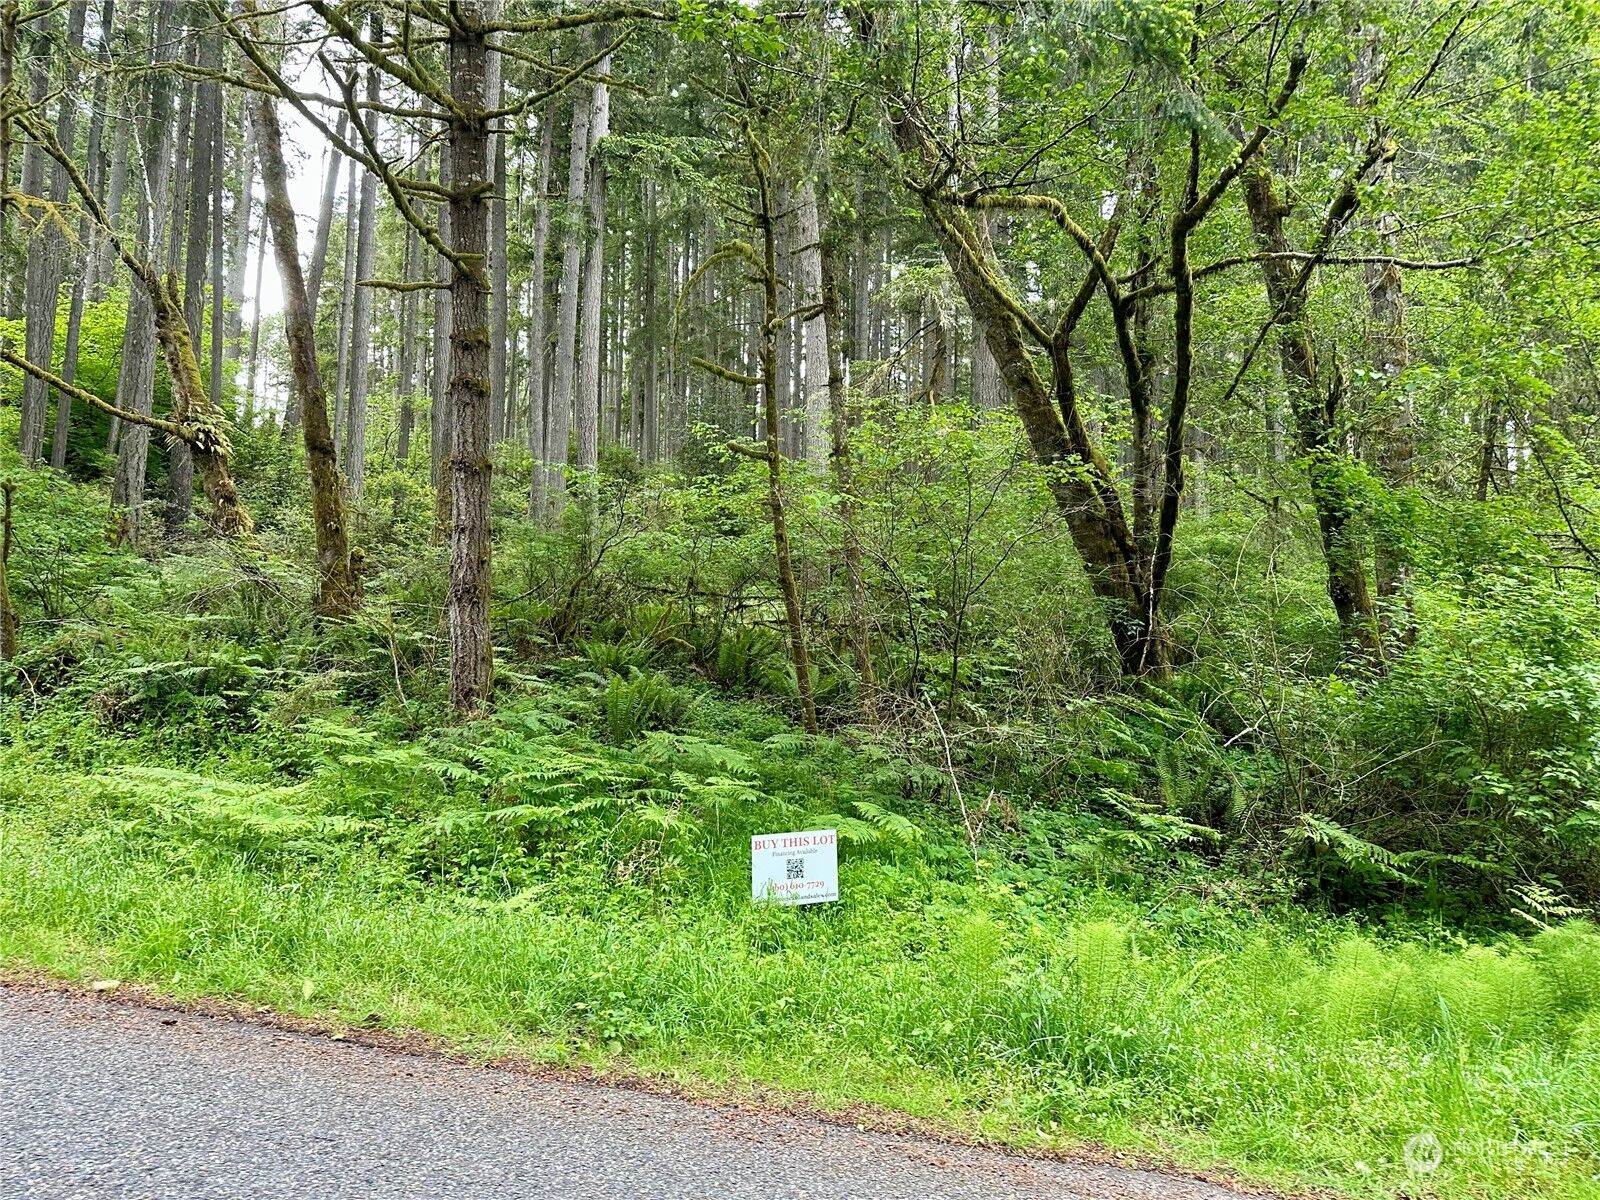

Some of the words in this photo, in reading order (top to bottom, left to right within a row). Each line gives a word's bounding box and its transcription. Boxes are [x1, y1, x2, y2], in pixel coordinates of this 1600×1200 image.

[754, 839, 778, 850] BUY
[782, 837, 810, 848] THIS
[813, 834, 834, 845] LOT
[789, 880, 825, 890] 610-7729
